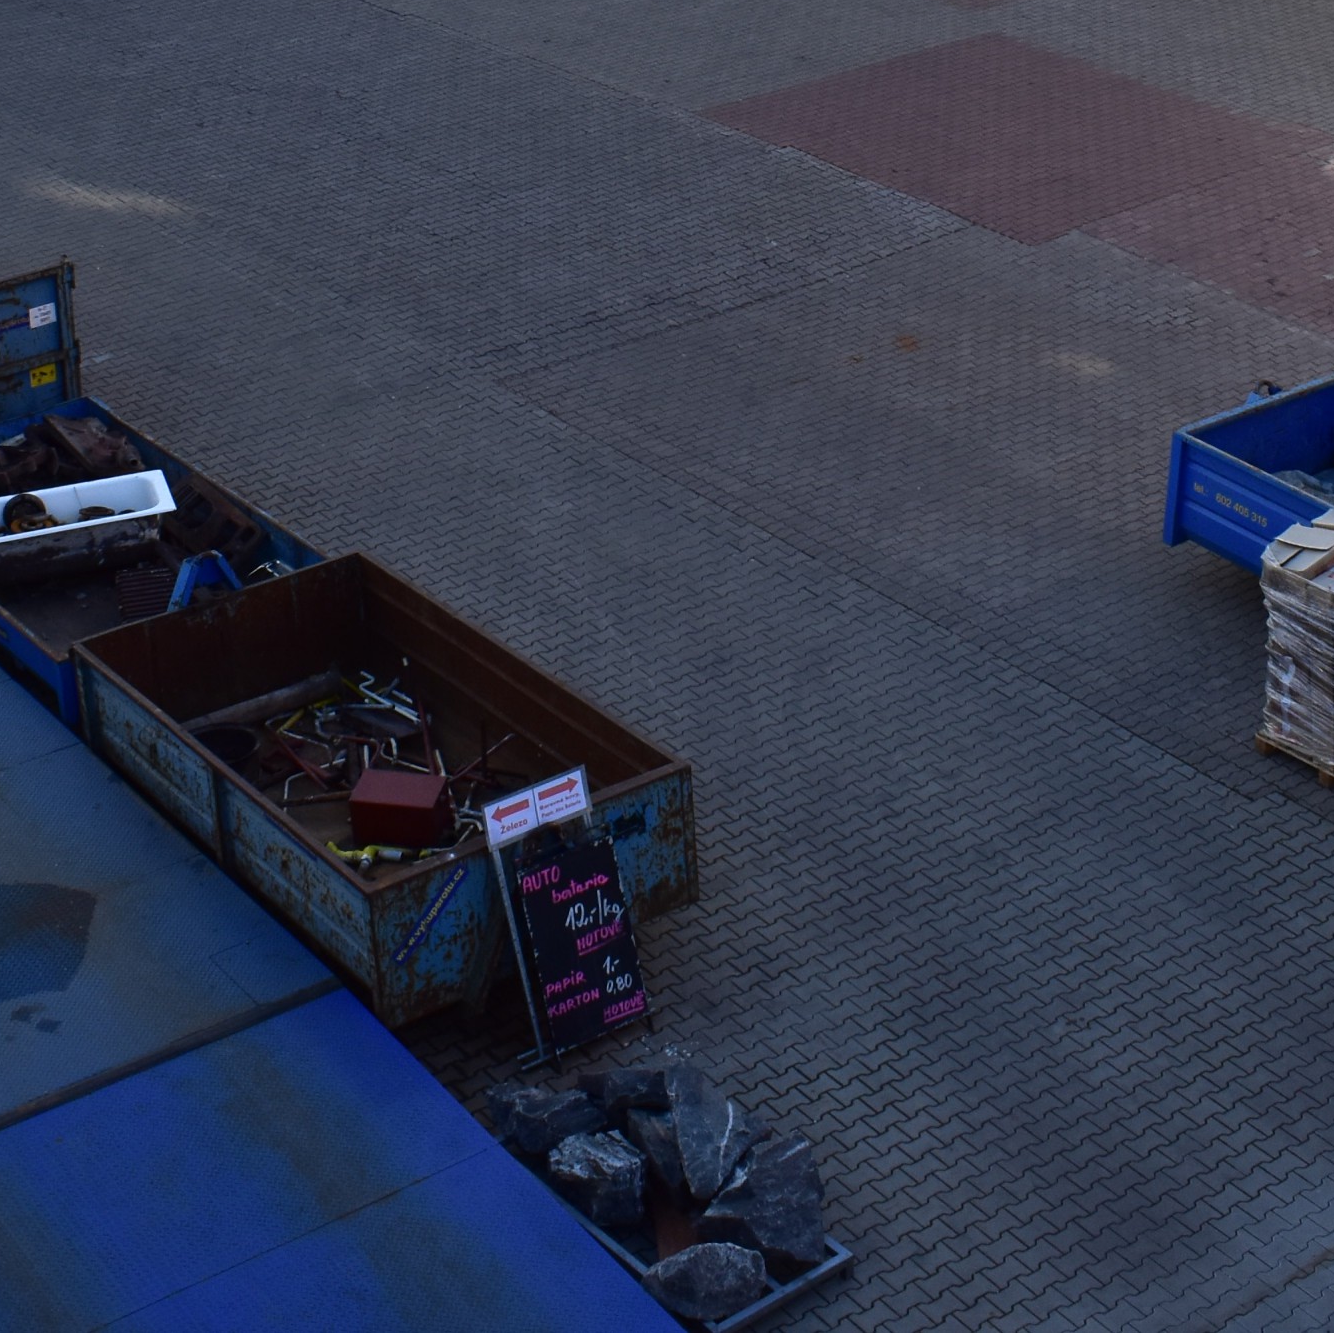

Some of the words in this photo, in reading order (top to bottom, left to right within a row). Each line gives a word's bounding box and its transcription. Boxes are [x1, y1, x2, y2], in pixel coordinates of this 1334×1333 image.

[1215, 492, 1232, 508] 602
[1233, 502, 1249, 518] 405
[1251, 511, 1268, 528] 315
[500, 818, 528, 835] Železo
[522, 865, 560, 895] AUTO
[547, 988, 600, 1018] KARTON
[606, 973, 633, 995] 0,80
[603, 991, 645, 1018] HOTOVĚ
